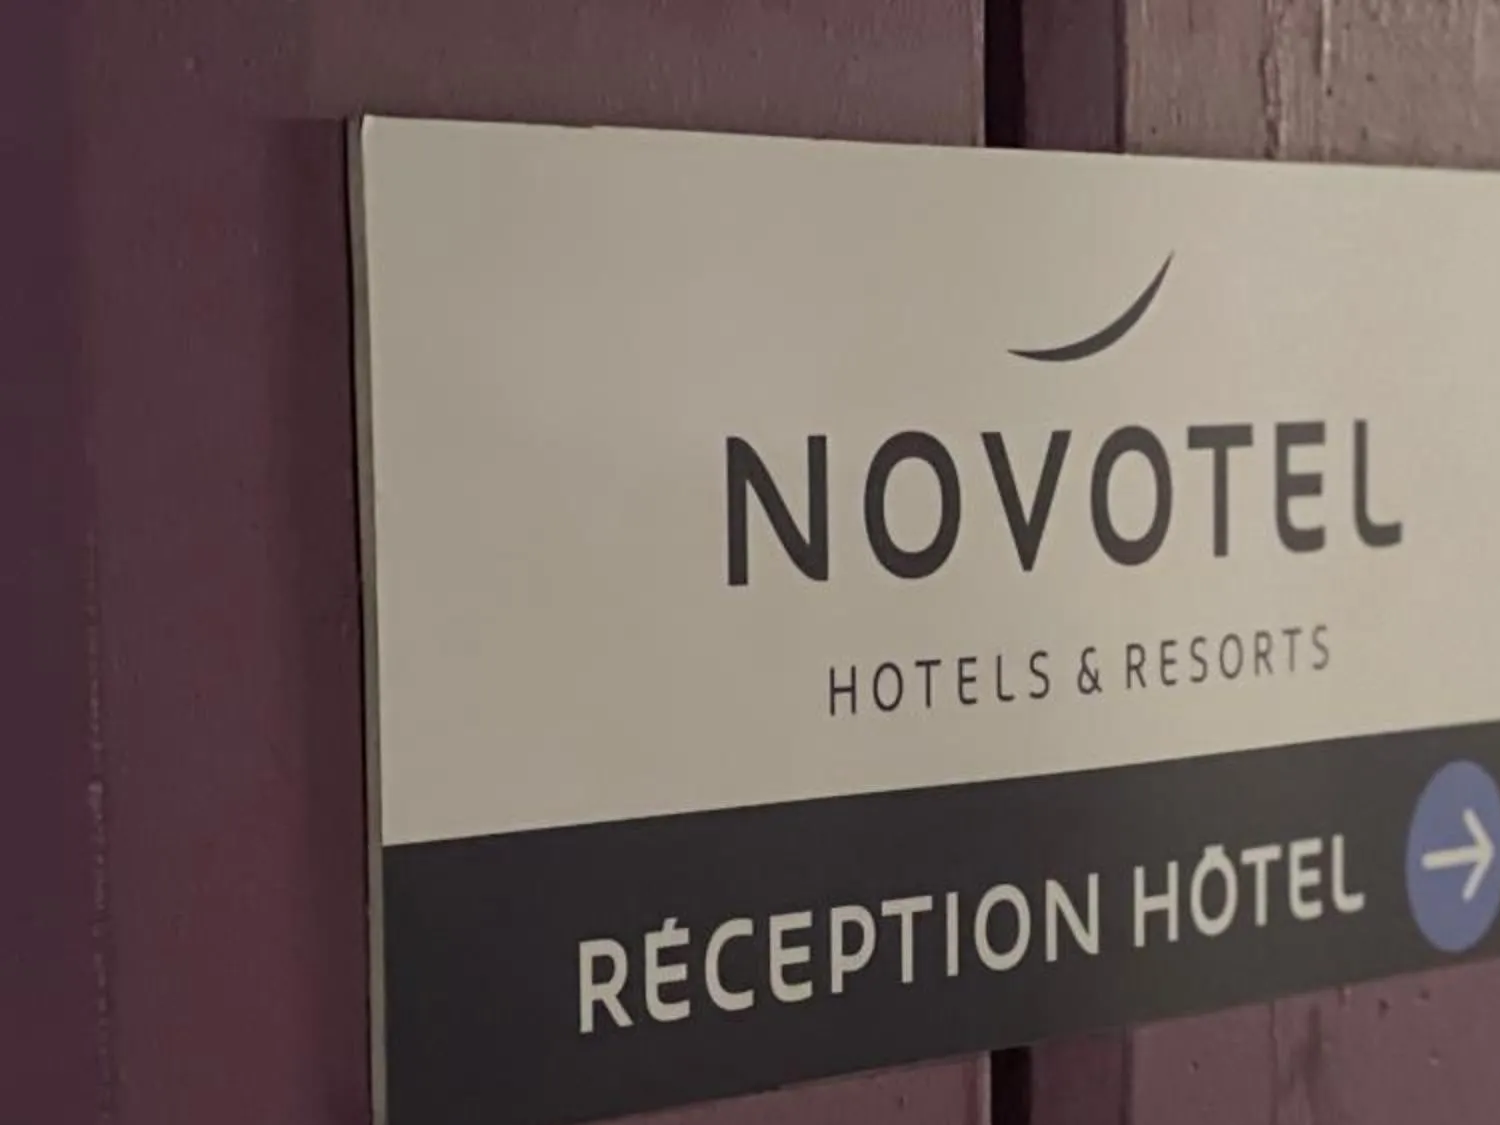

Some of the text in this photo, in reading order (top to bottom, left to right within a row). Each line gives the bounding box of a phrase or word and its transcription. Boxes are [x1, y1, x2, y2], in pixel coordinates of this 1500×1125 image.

[725, 419, 1404, 588] NOVOTEL
[828, 625, 1333, 718] HOTELS & RESORTS
[577, 833, 1366, 1034] RÉCEPTION HÔTEL
